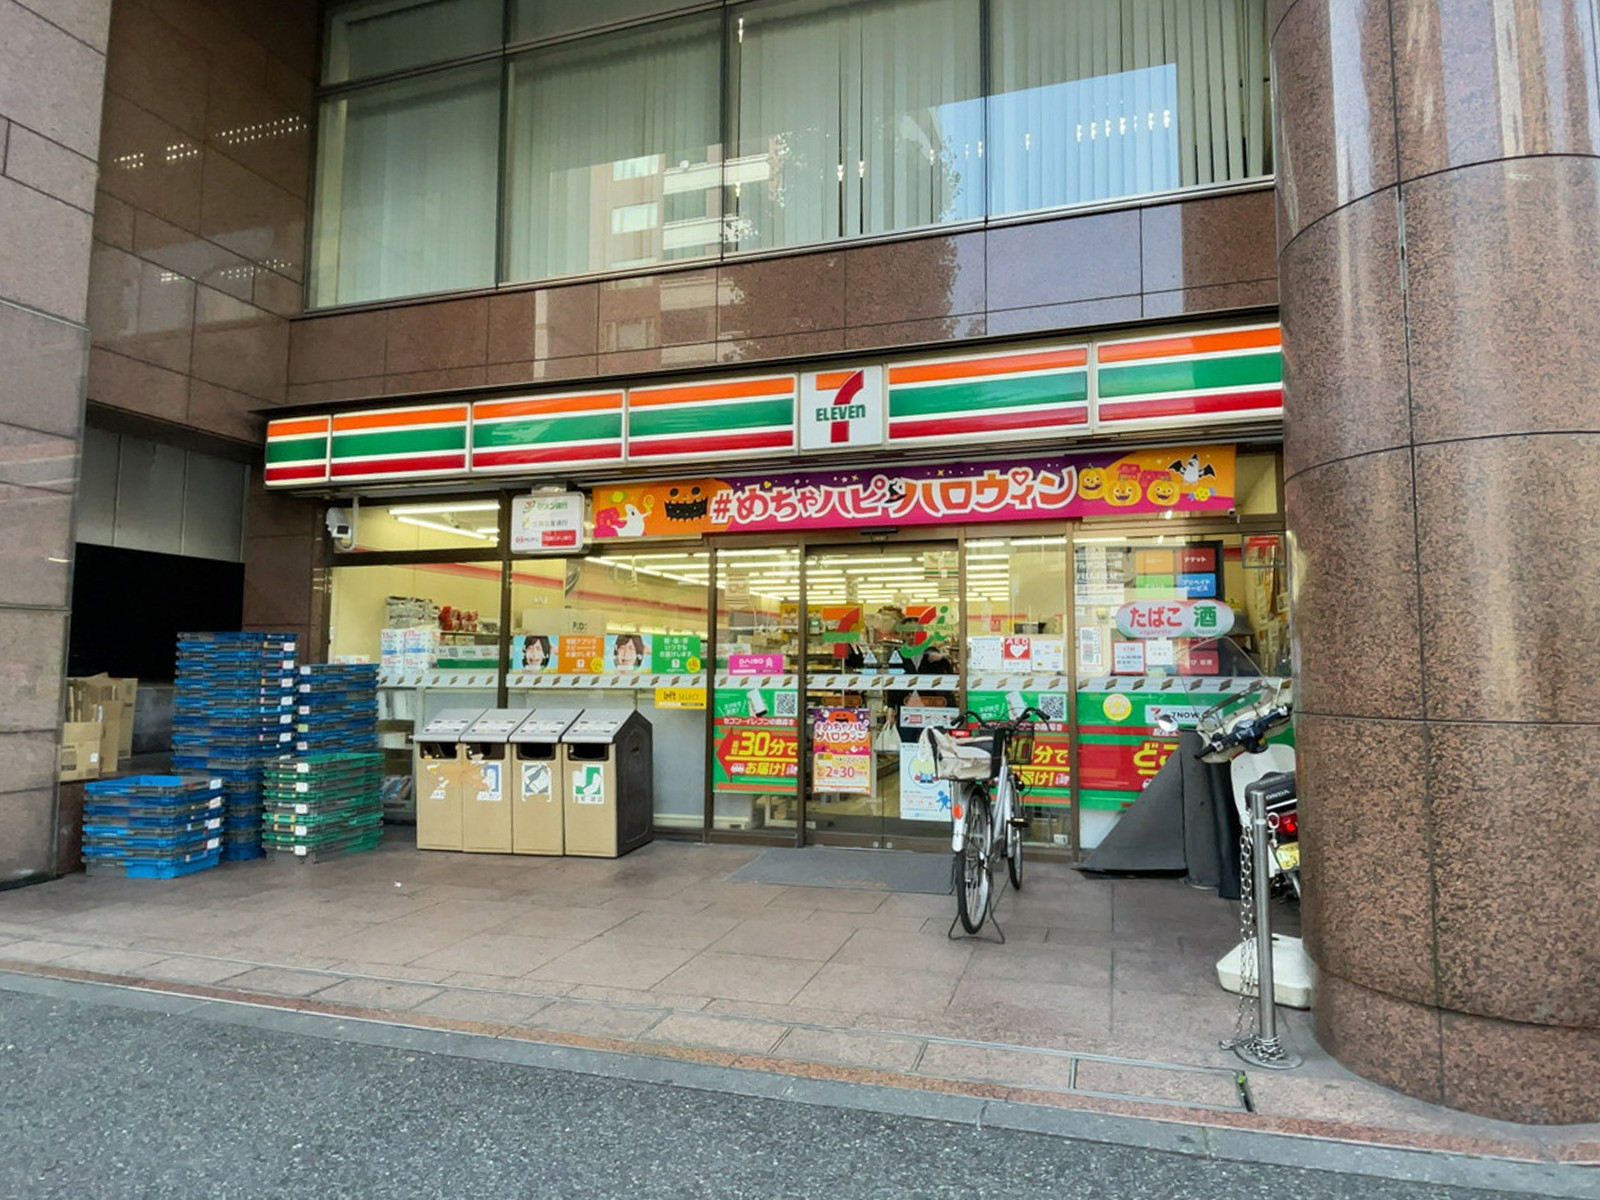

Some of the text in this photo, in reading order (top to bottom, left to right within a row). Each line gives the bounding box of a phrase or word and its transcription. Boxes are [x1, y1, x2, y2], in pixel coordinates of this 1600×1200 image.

[1130, 605, 1217, 629] たばこ 酒
[1005, 638, 1030, 646] AED
[1265, 789, 1290, 800] ONDA
